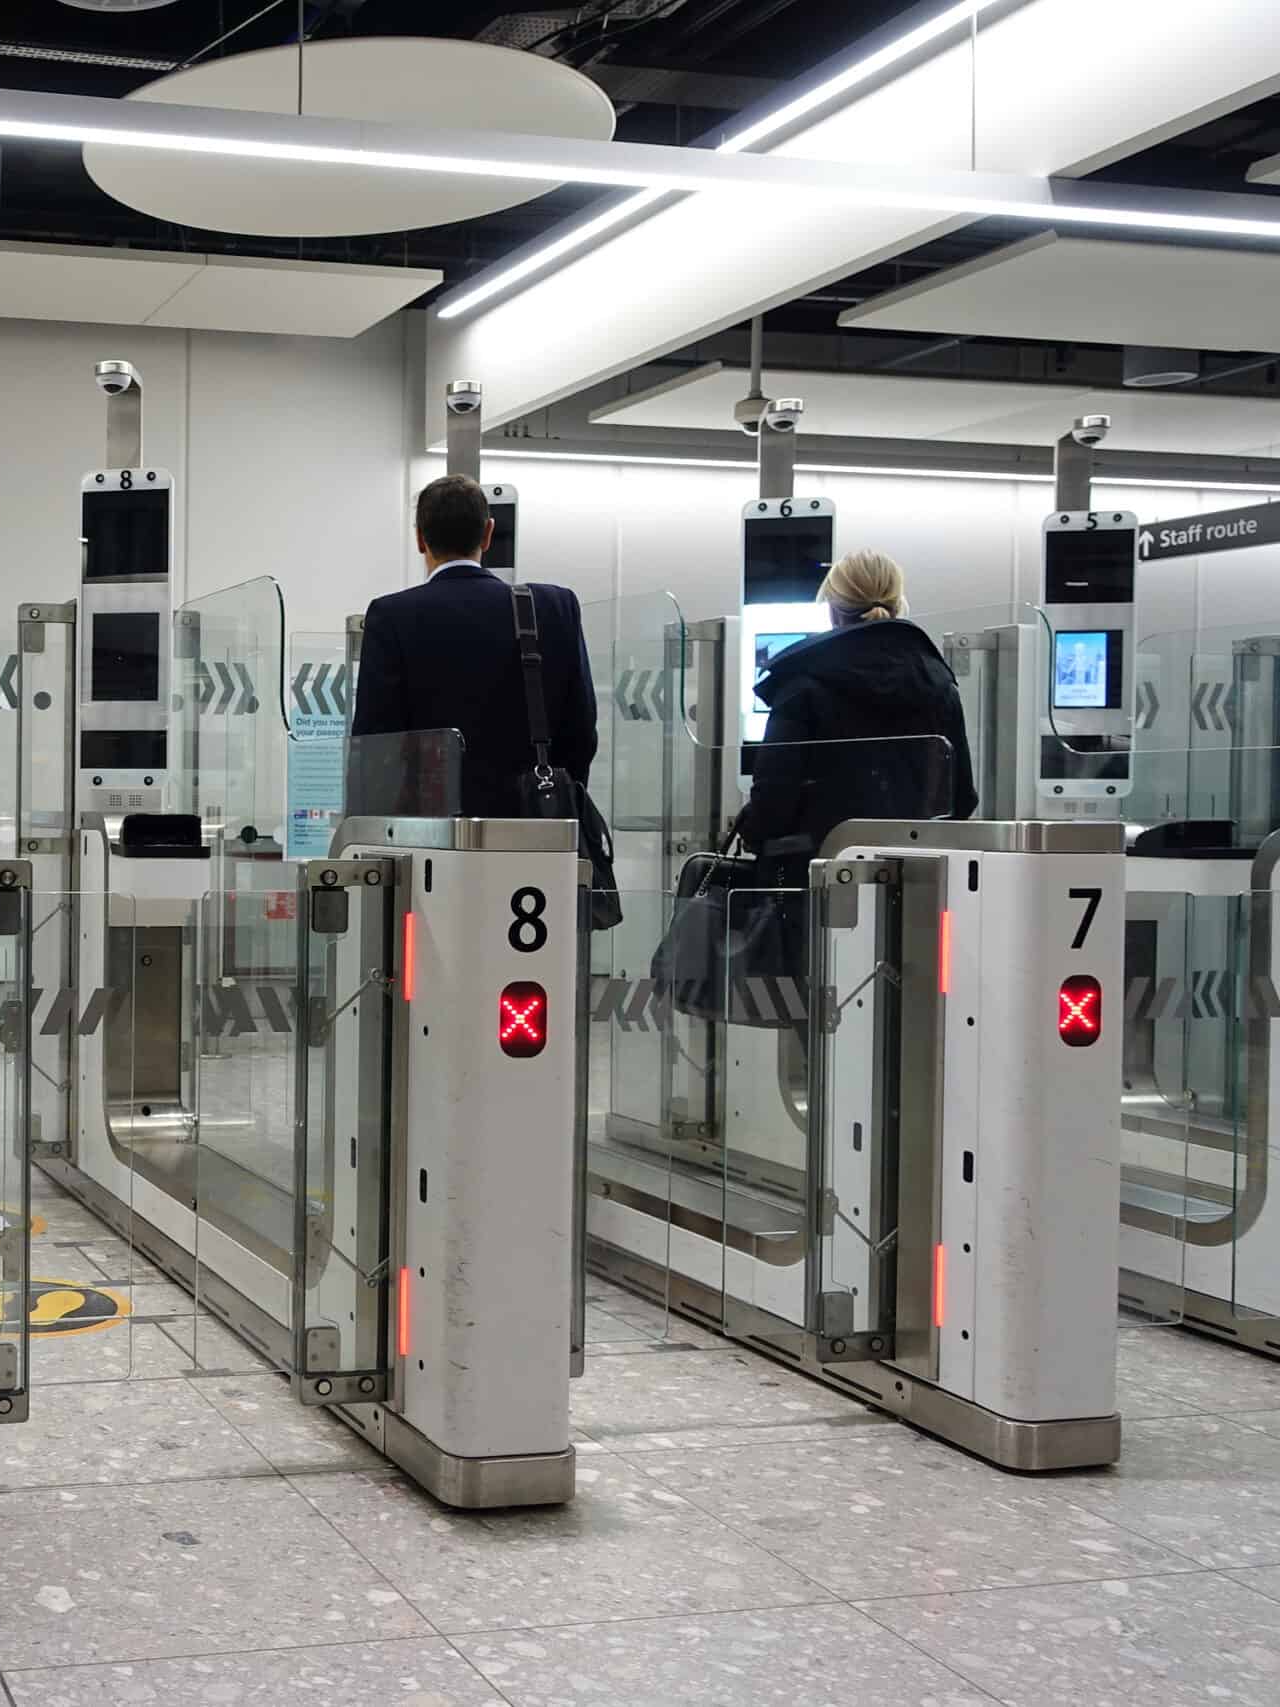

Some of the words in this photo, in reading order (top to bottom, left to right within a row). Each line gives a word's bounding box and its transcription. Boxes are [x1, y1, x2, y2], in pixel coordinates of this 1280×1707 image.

[119, 469, 133, 489] 8
[779, 498, 793, 518] 6
[1086, 512, 1099, 530] 5
[1160, 523, 1203, 548] Staff
[1206, 518, 1258, 540] route
[507, 886, 548, 953] 8
[1068, 887, 1103, 950] 7
